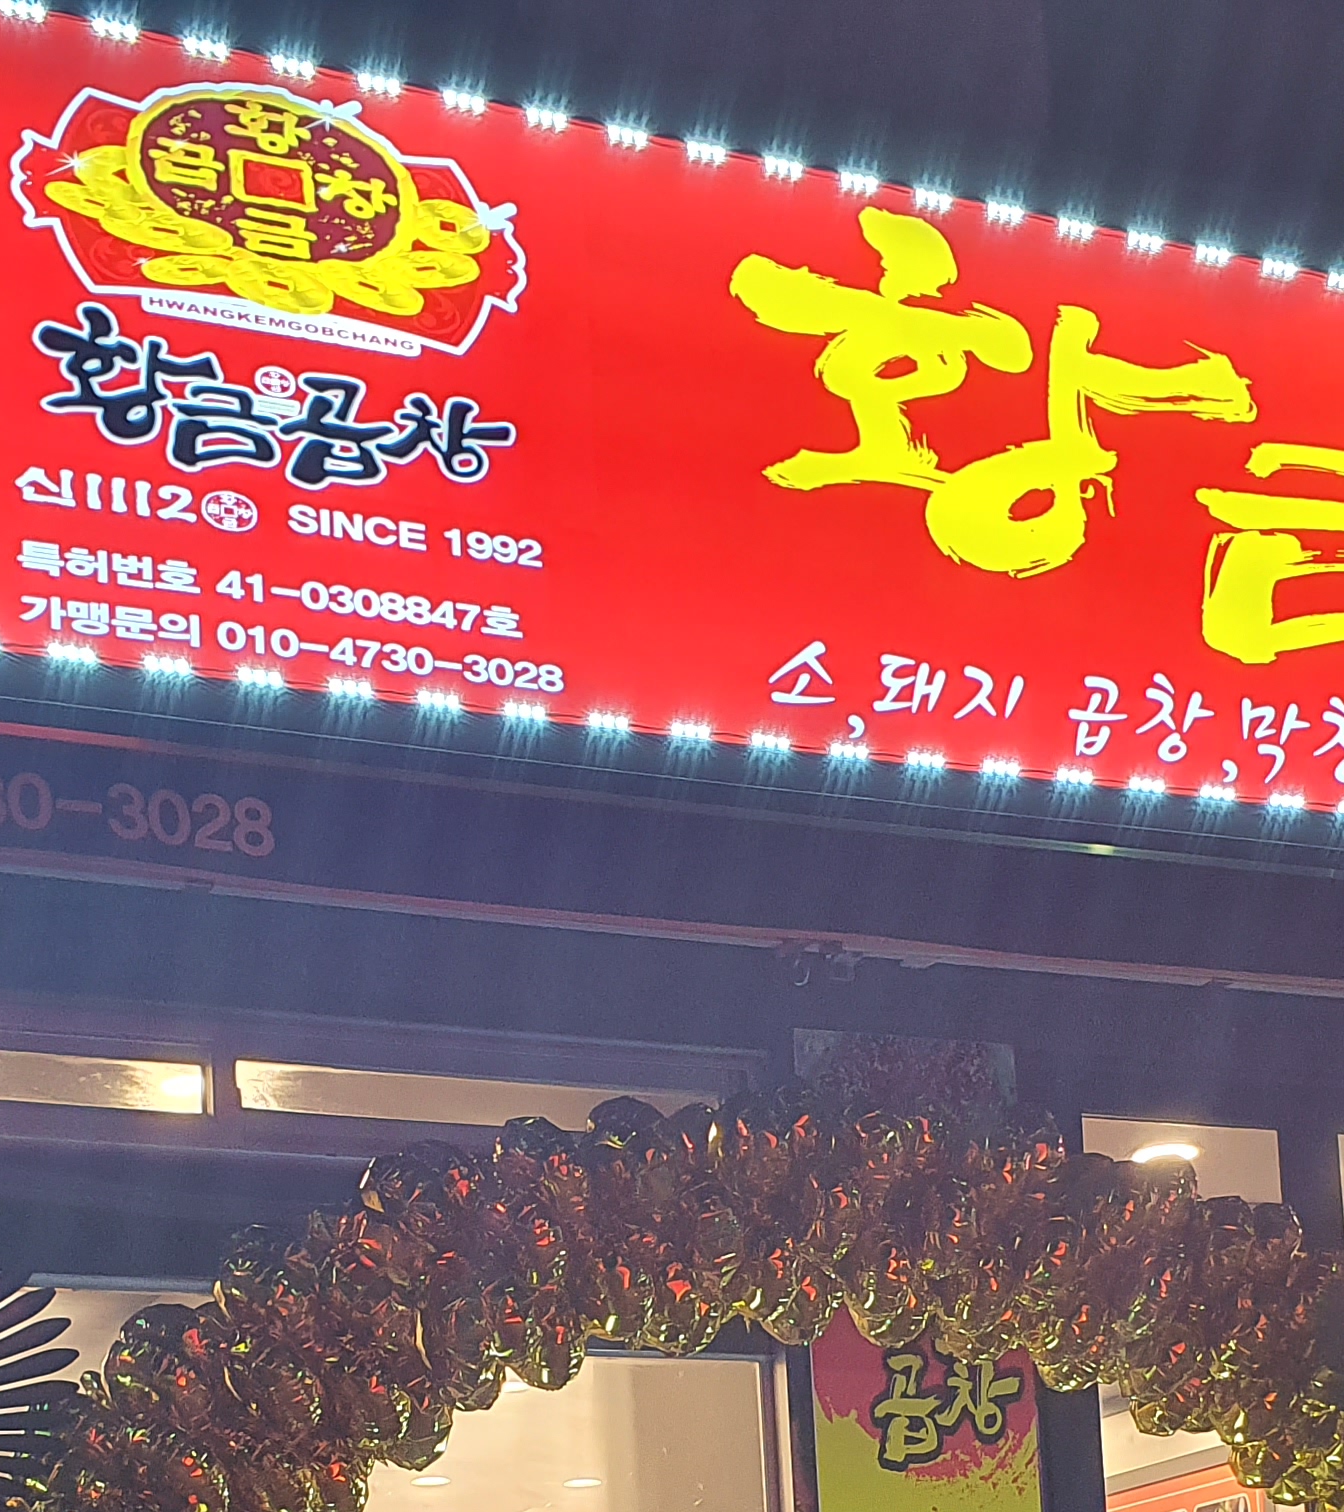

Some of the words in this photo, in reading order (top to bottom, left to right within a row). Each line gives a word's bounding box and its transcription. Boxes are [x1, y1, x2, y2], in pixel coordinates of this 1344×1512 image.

[146, 295, 416, 352] HWANGKEMGOBCHANG
[40, 309, 509, 480] 황금곱창
[287, 505, 427, 552] SINCE
[445, 529, 543, 568] 1992
[18, 540, 201, 595] 특허번호
[216, 572, 523, 640] 41-0308847호
[19, 595, 201, 649] 가맹문의
[218, 624, 564, 693] 010-4730-3028
[876, 1340, 1018, 1470] 곱창
